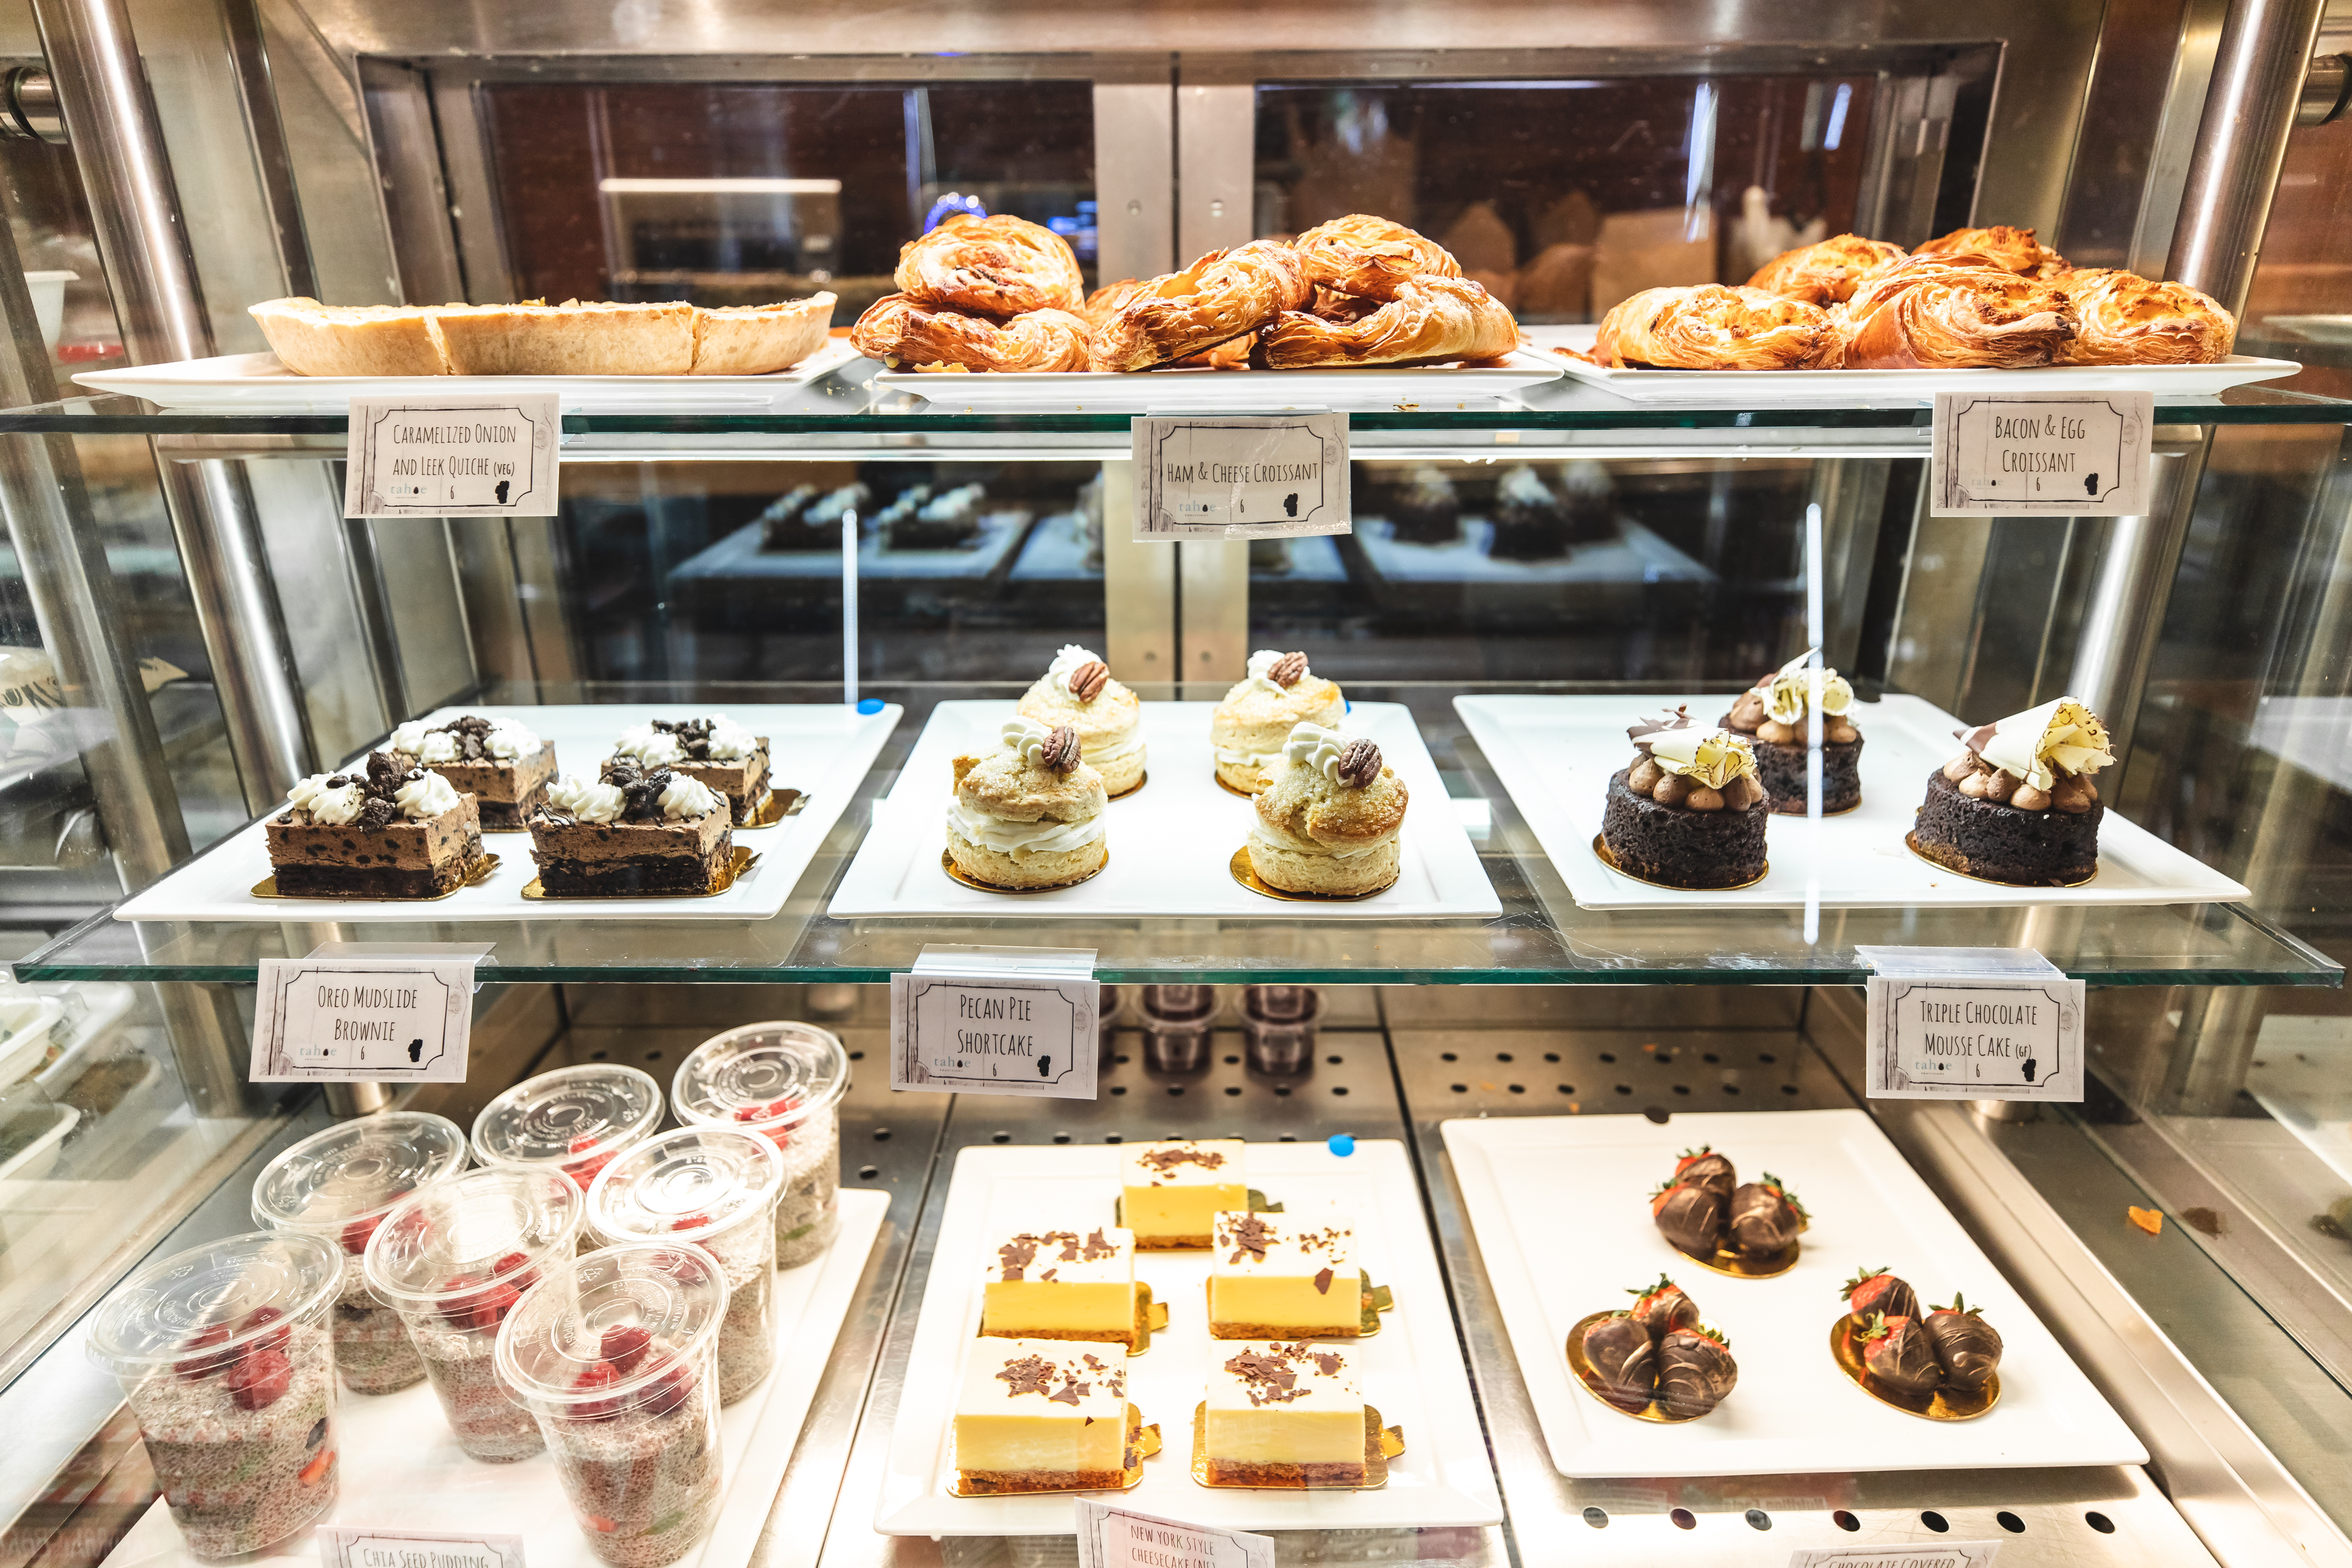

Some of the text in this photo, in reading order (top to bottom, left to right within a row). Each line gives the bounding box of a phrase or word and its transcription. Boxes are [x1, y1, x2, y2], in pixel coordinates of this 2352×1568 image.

[393, 423, 516, 444] CARAMELIZED ONION
[1996, 414, 2084, 439] BACON & EGG
[393, 456, 514, 478] AND LEEK QUICHE (VEG)
[2003, 450, 2075, 472] CROISSANT
[1168, 462, 1317, 483] HAM & CHEESE CROISSANT
[450, 486, 454, 500] 6
[2036, 477, 2040, 491] 6
[1240, 499, 1244, 513] 6
[318, 985, 417, 1008] OREO MUDSLIDE
[961, 994, 1031, 1021] PECAN PIE
[1921, 1001, 2037, 1025] TRIPLE CHOCOLATE
[335, 1019, 395, 1041] BROWNIE
[361, 1047, 365, 1059] 6
[958, 1029, 1033, 1057] SHORTCAKE
[1926, 1034, 2032, 1059] MOUSSE CAKE (GF)
[993, 1064, 997, 1076] 6
[1976, 1064, 1980, 1077] 6
[1131, 1525, 1214, 1555] NEW YORK STYLE
[364, 1549, 488, 1568] CHIA SEED PUDDING
[1132, 1548, 1189, 1568] CHEESECAKE
